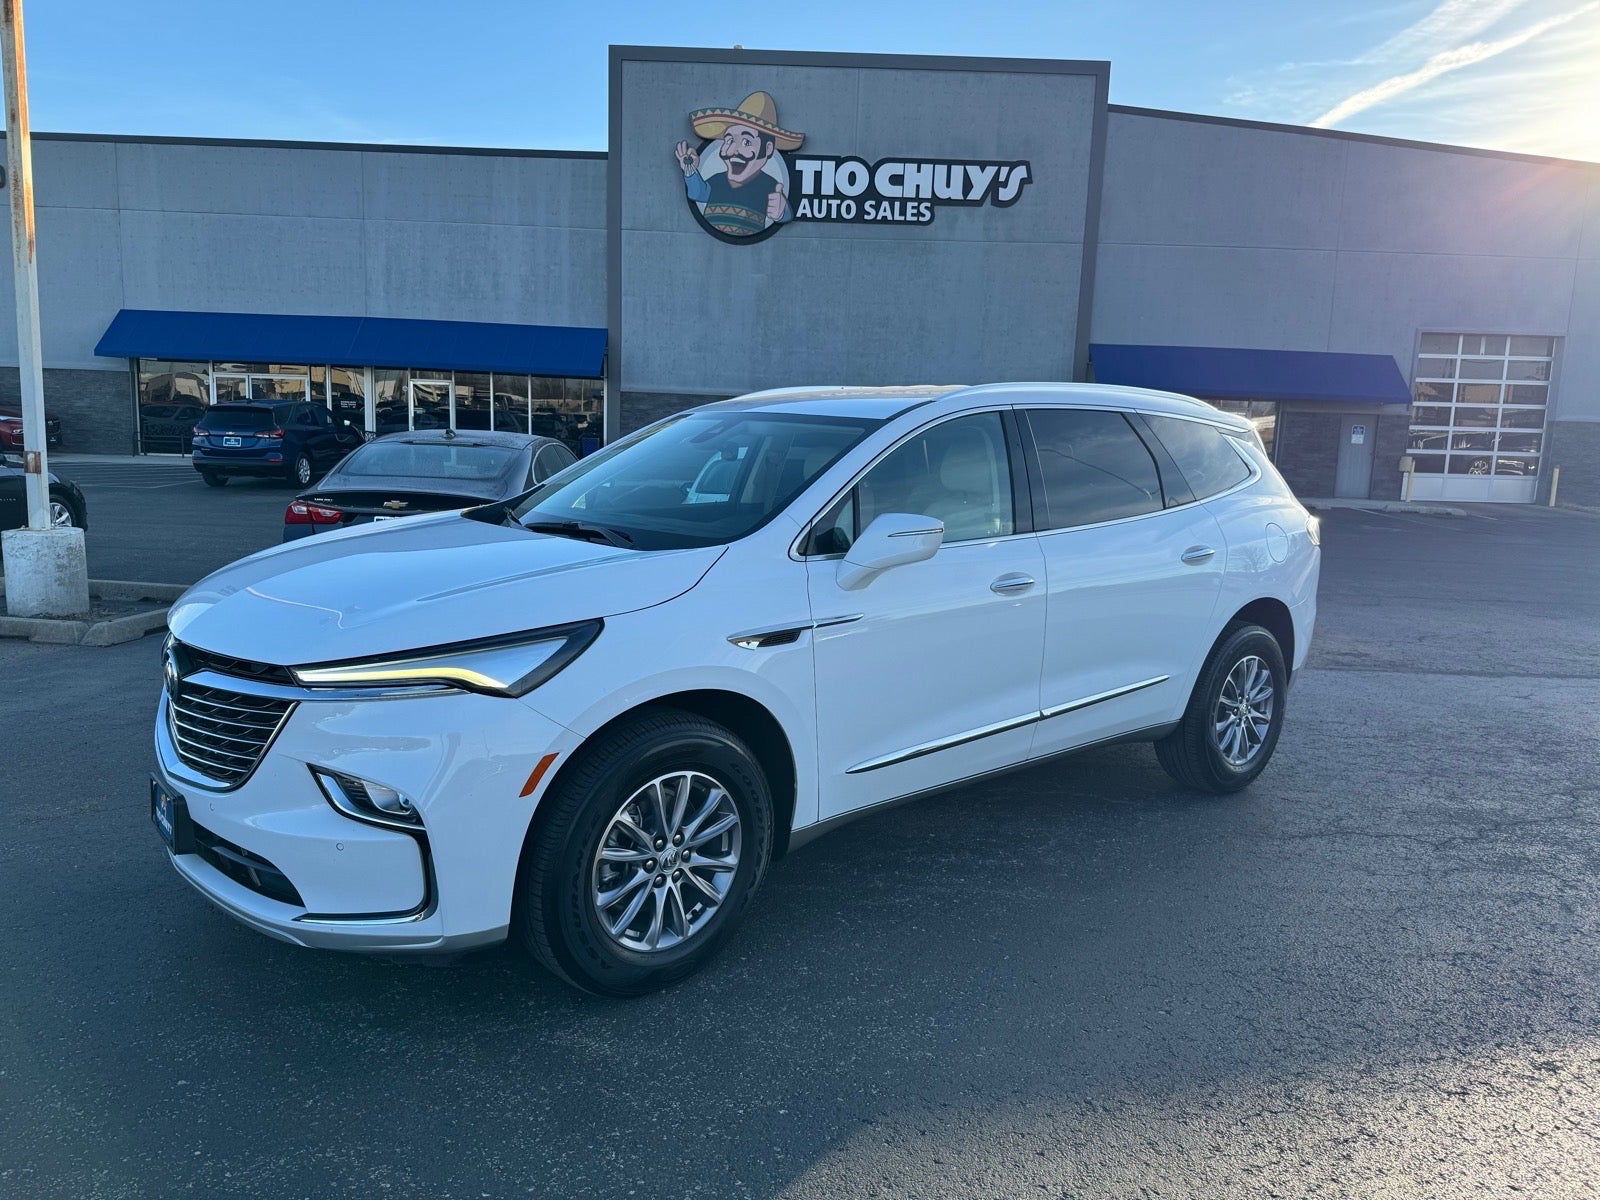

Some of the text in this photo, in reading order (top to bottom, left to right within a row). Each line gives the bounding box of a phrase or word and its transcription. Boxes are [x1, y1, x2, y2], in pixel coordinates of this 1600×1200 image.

[796, 160, 870, 197] TIO
[796, 198, 932, 222] AUTO SALES
